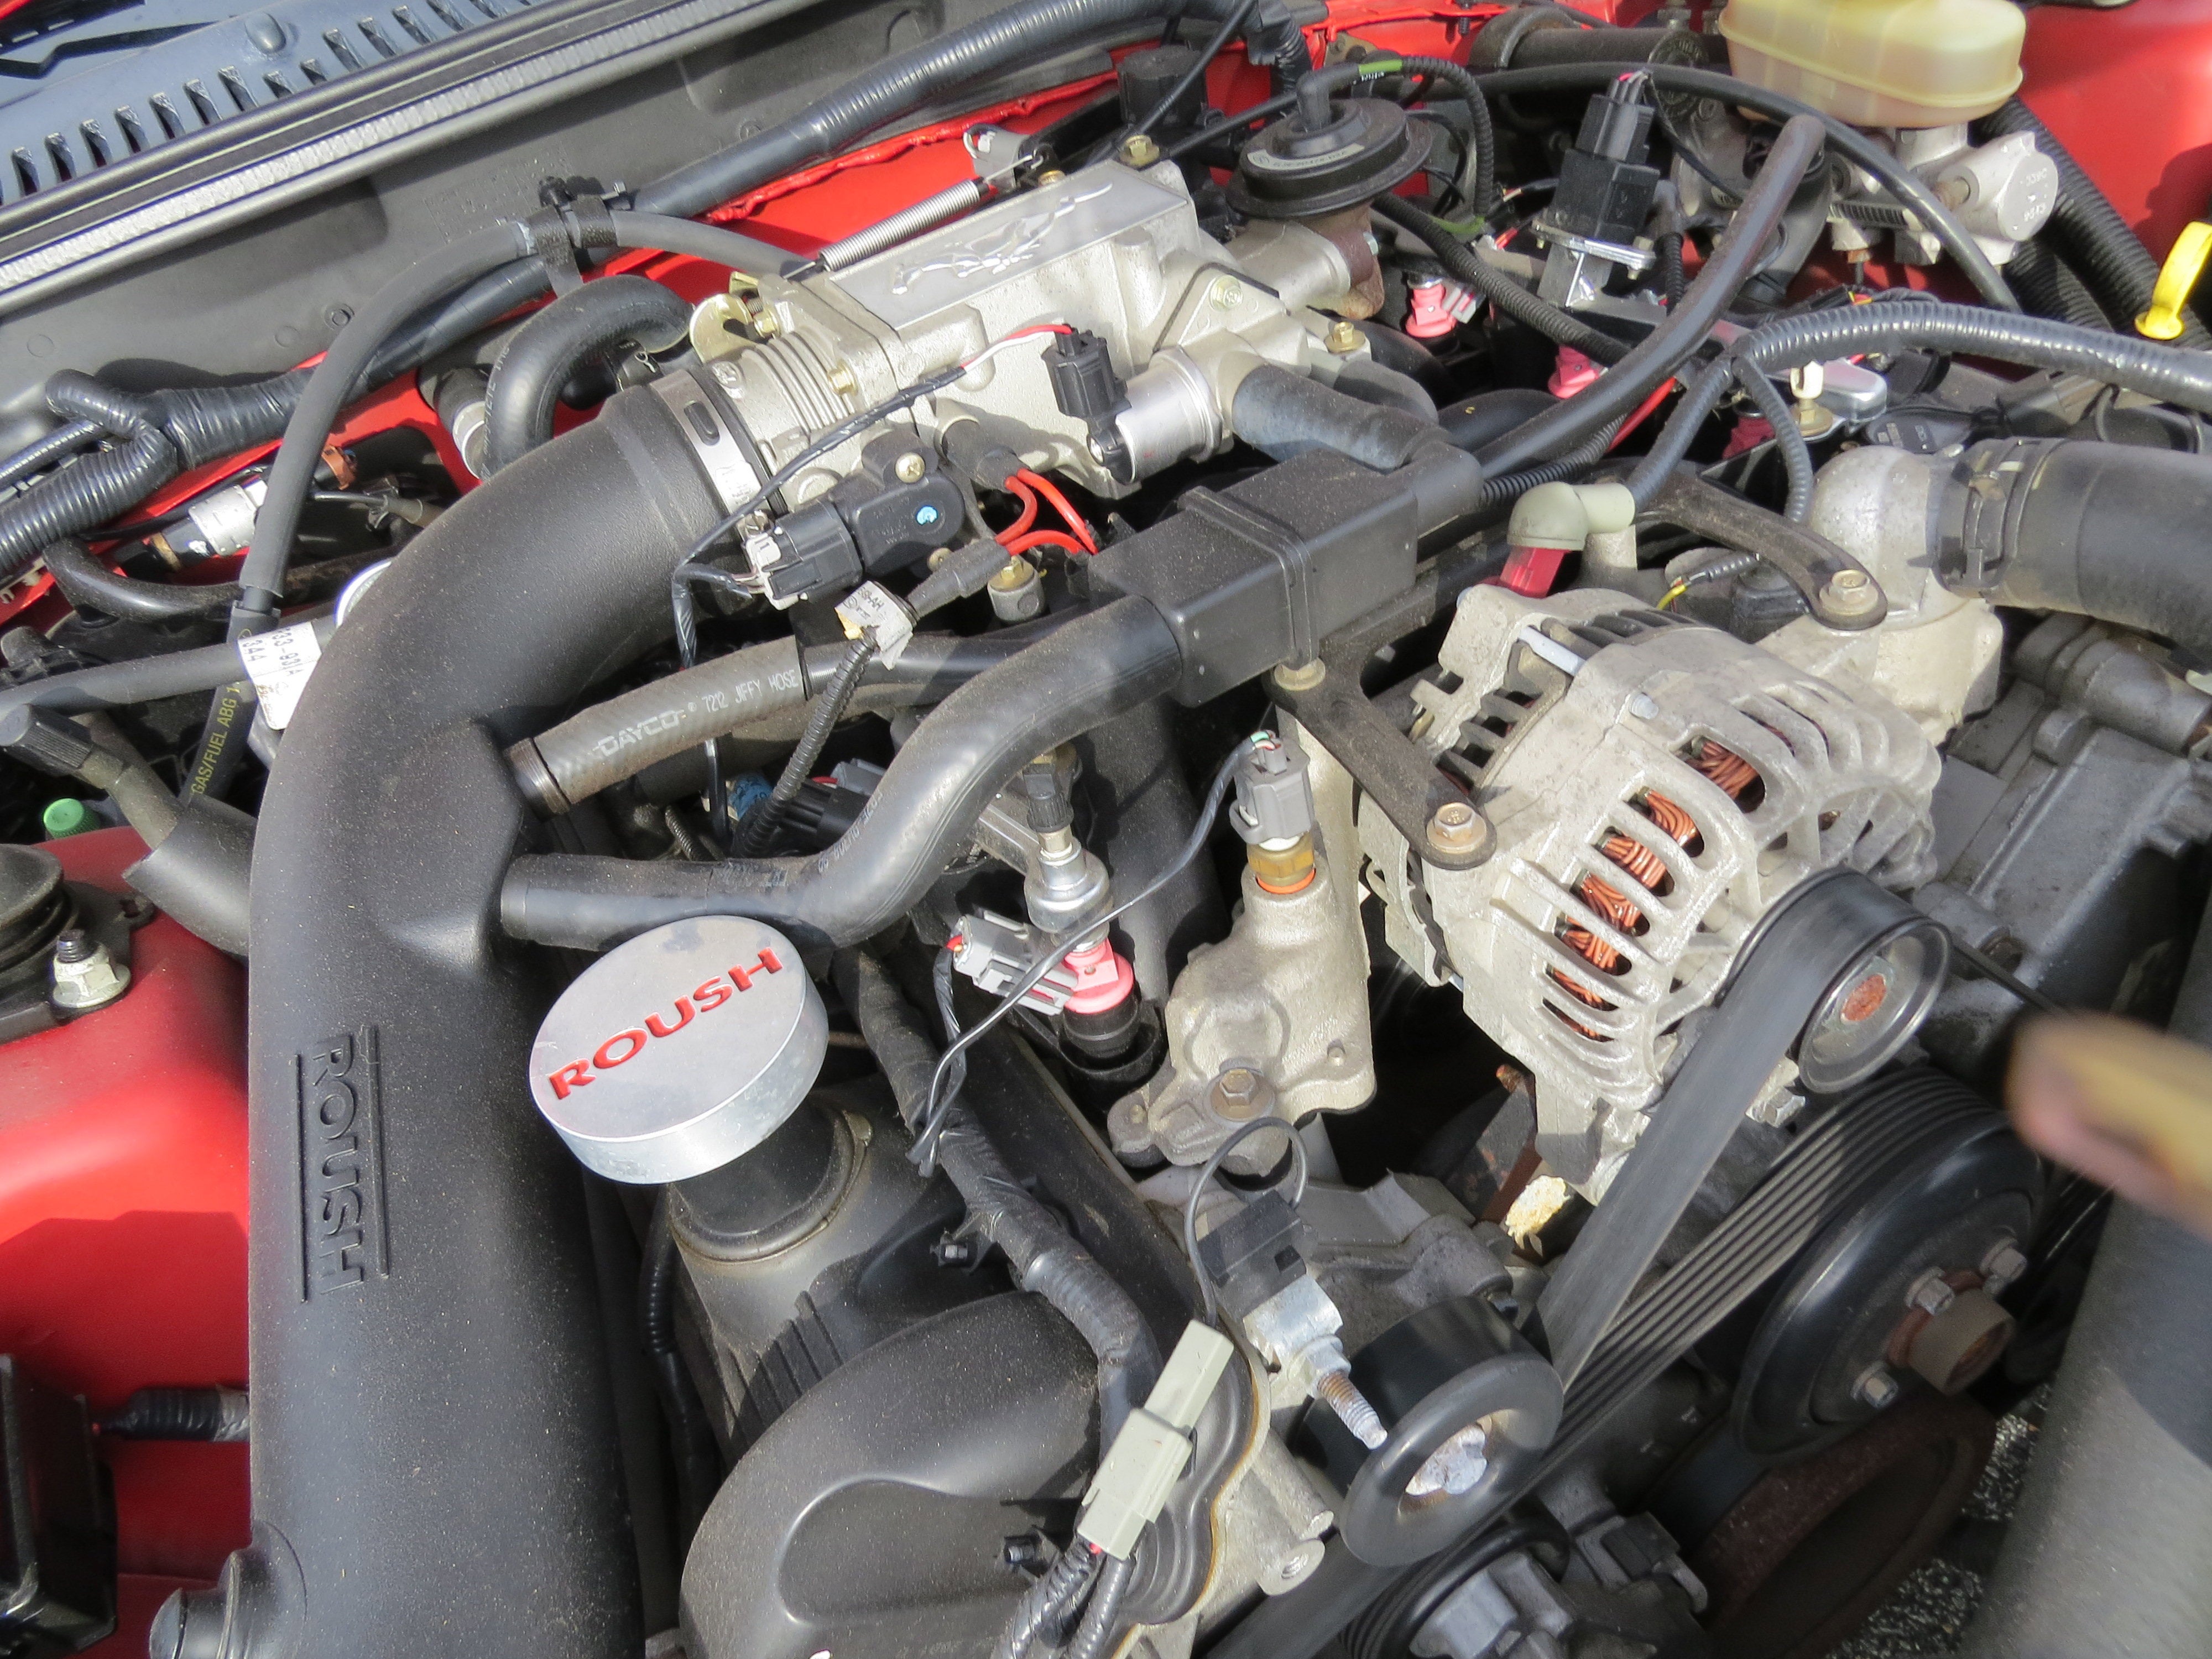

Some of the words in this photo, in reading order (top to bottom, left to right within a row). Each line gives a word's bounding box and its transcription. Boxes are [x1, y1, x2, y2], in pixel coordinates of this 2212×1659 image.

[190, 732, 227, 794] GAS/FUEL
[217, 697, 237, 728] ABG
[594, 709, 684, 757] DAYCO
[701, 691, 728, 713] 7212
[734, 679, 763, 703] JIFFY
[768, 669, 799, 692] HOSE
[549, 947, 783, 1100] ROUSH
[312, 1034, 363, 1295] ROUSH
